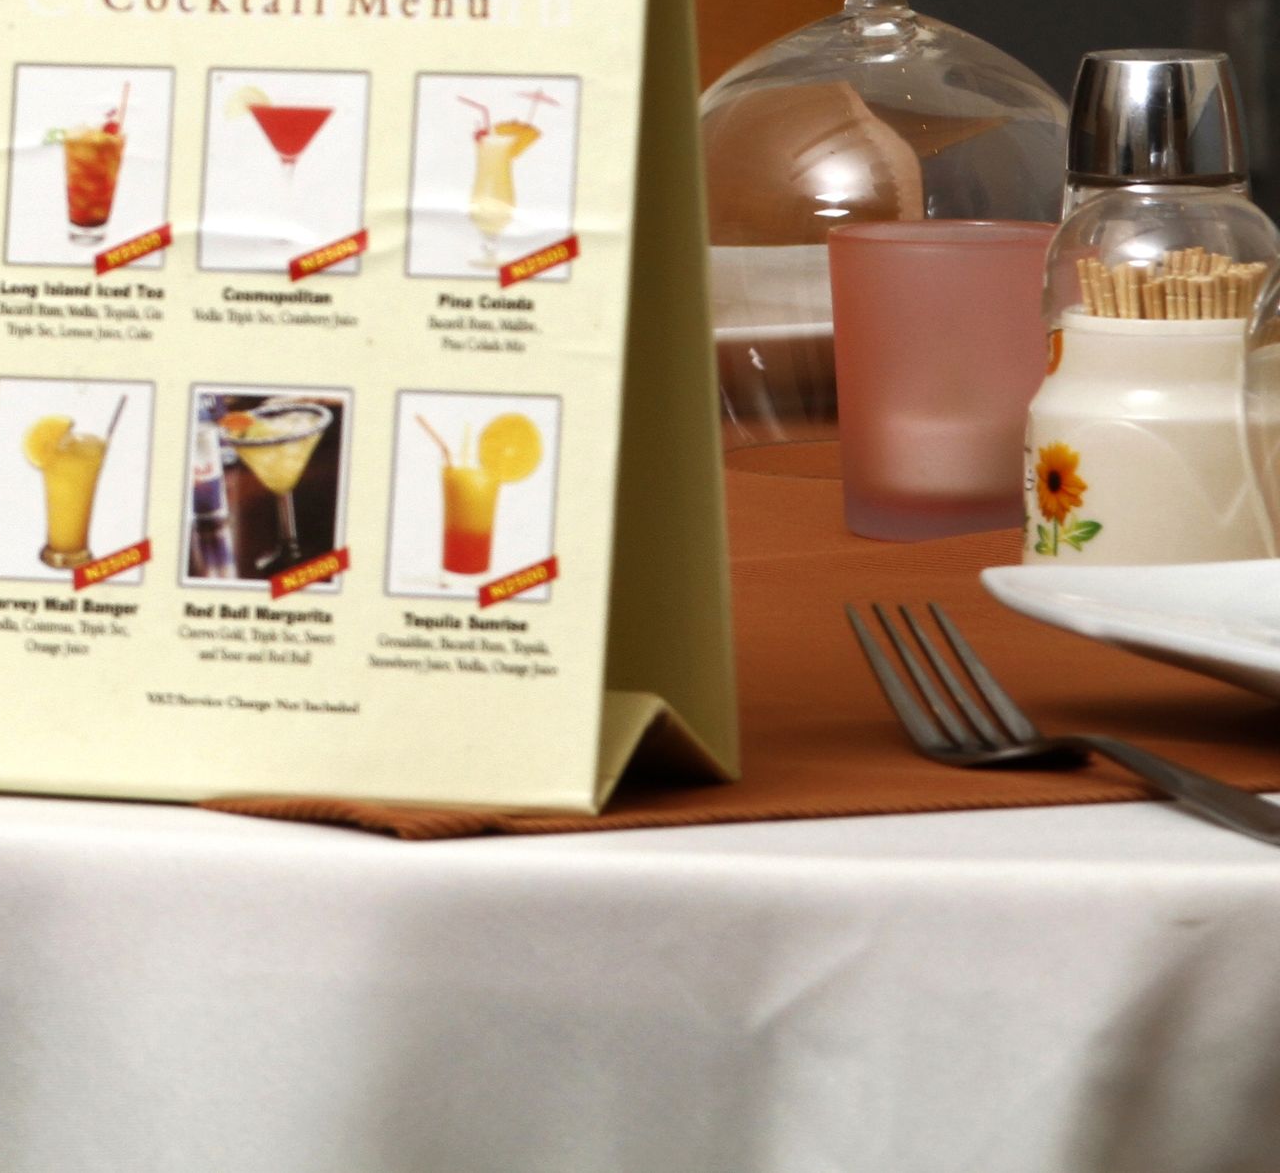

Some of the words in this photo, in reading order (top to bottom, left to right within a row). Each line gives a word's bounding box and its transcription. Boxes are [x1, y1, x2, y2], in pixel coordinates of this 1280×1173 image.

[0, 280, 38, 298] Long
[44, 282, 91, 297] Island
[96, 283, 131, 298] Iced
[137, 284, 164, 299] Tea
[222, 286, 333, 306] Cosmopolitan
[438, 293, 473, 309] Pina
[478, 295, 535, 311] Colada
[43, 596, 77, 612] Wall
[82, 598, 139, 618] Banger
[184, 602, 215, 618] Red
[219, 604, 250, 619] Bull
[255, 605, 333, 626] Margarita
[404, 611, 461, 631] Tequila
[468, 614, 528, 632] Sunrise
[226, 694, 271, 713] Charge
[274, 697, 299, 710] Not
[303, 698, 360, 714] Included
